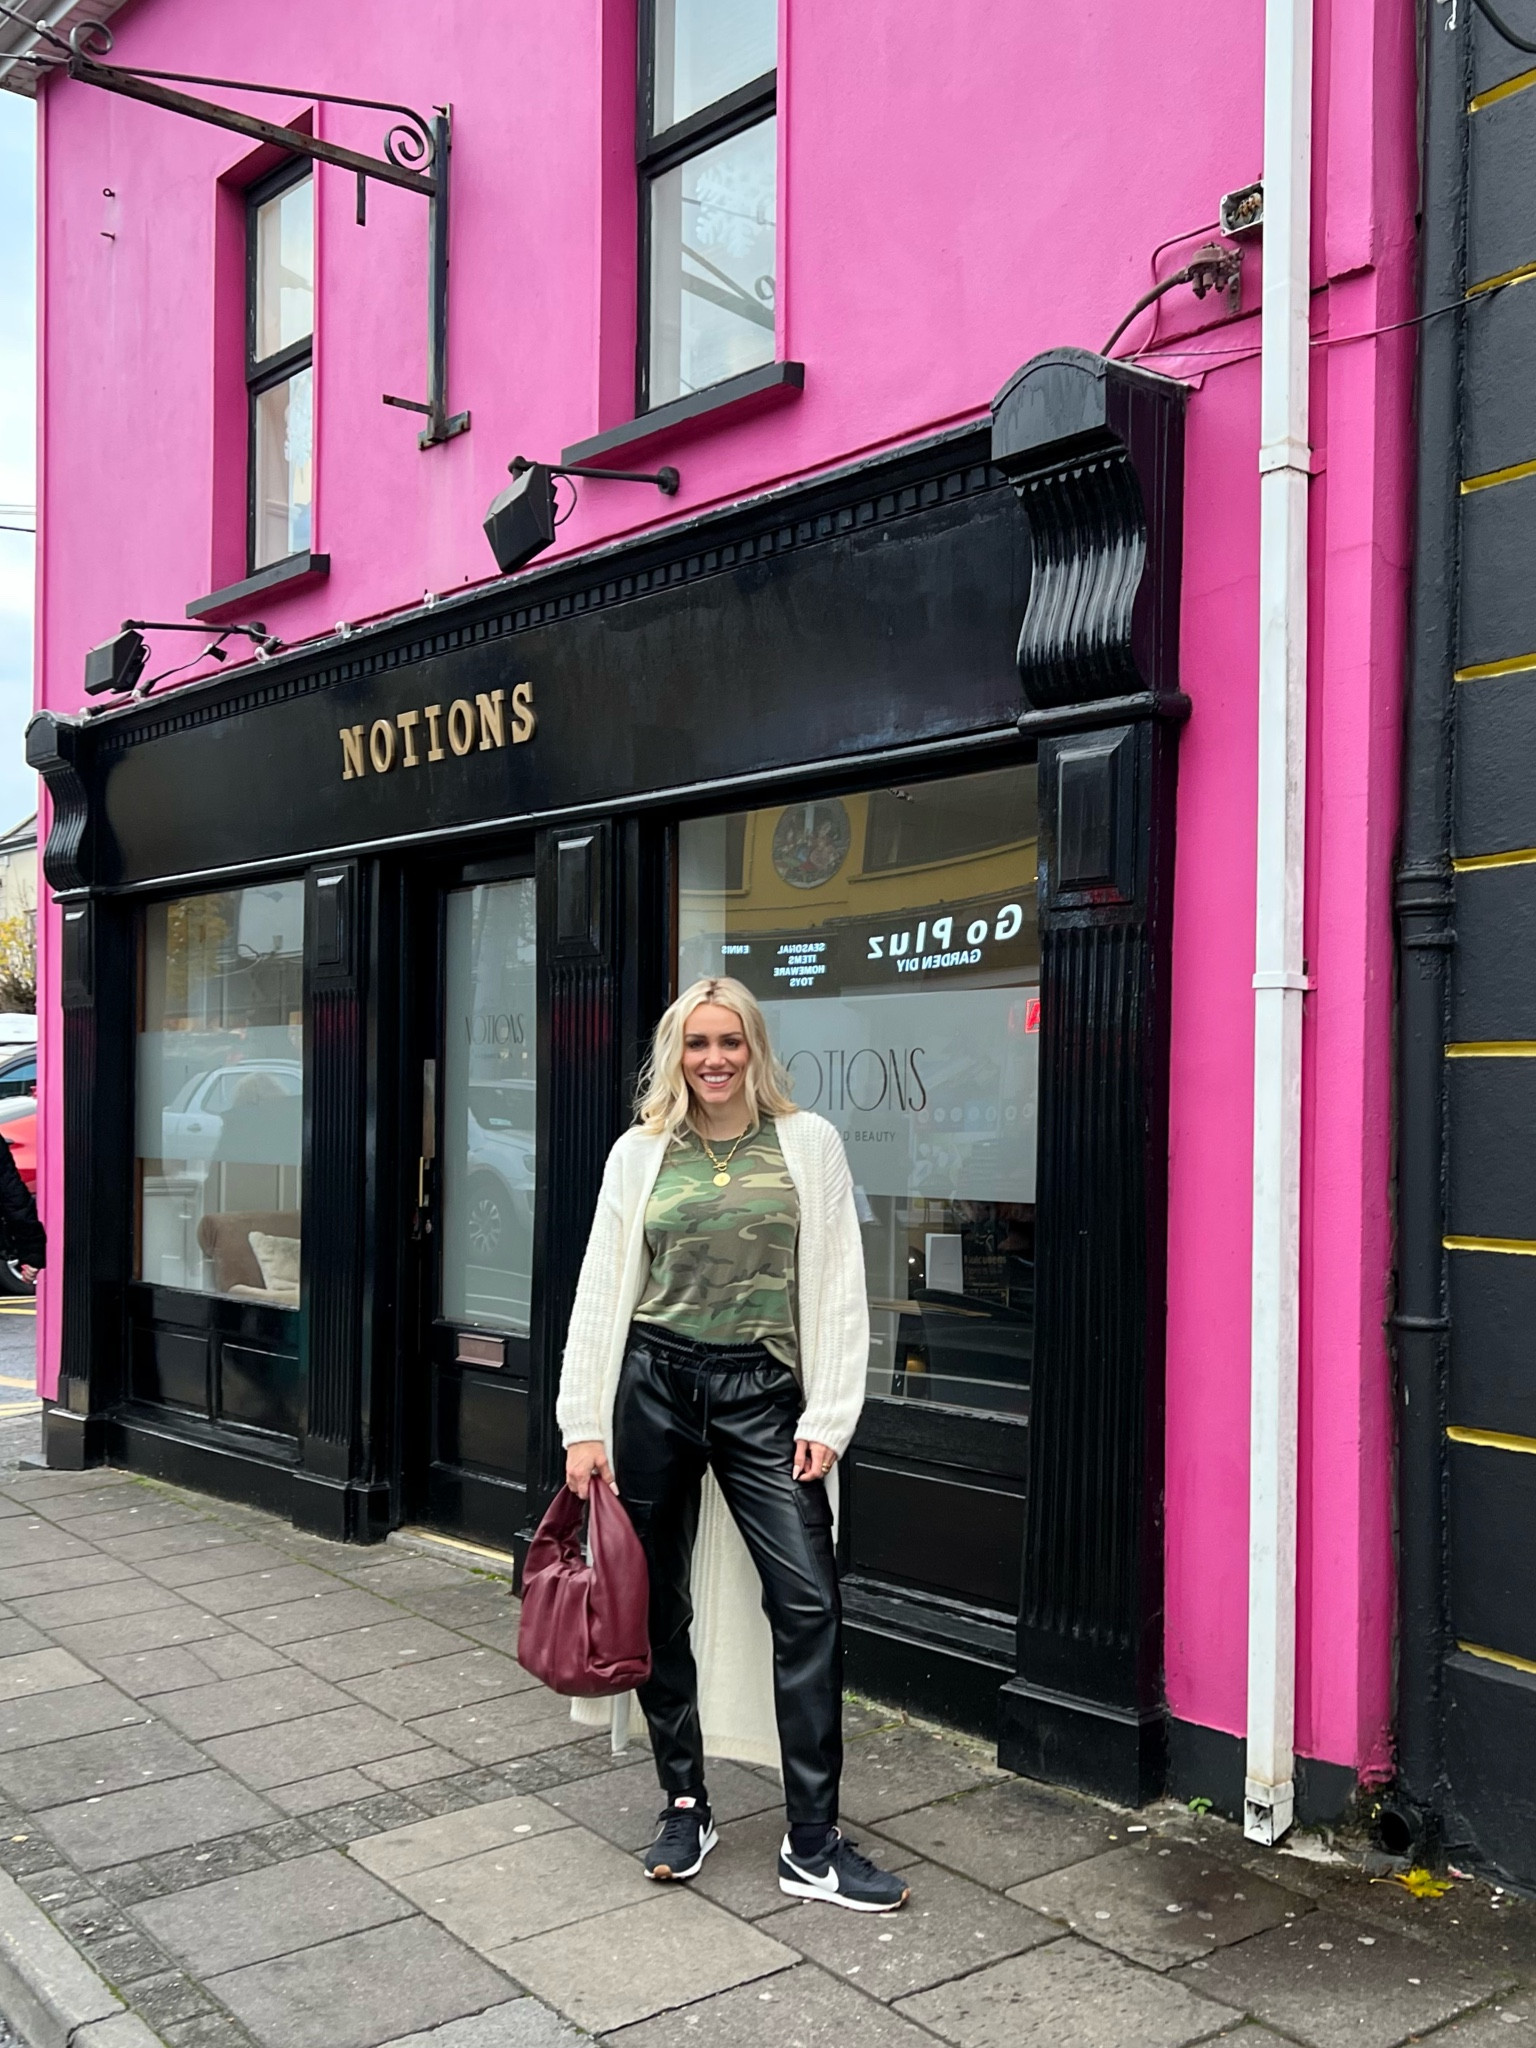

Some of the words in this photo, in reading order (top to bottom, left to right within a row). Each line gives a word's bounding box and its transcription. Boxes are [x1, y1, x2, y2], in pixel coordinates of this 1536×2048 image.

[339, 682, 537, 780] NOTIONS
[782, 1047, 927, 1111] OTIONS
[854, 1131, 896, 1142] BEAUTY
